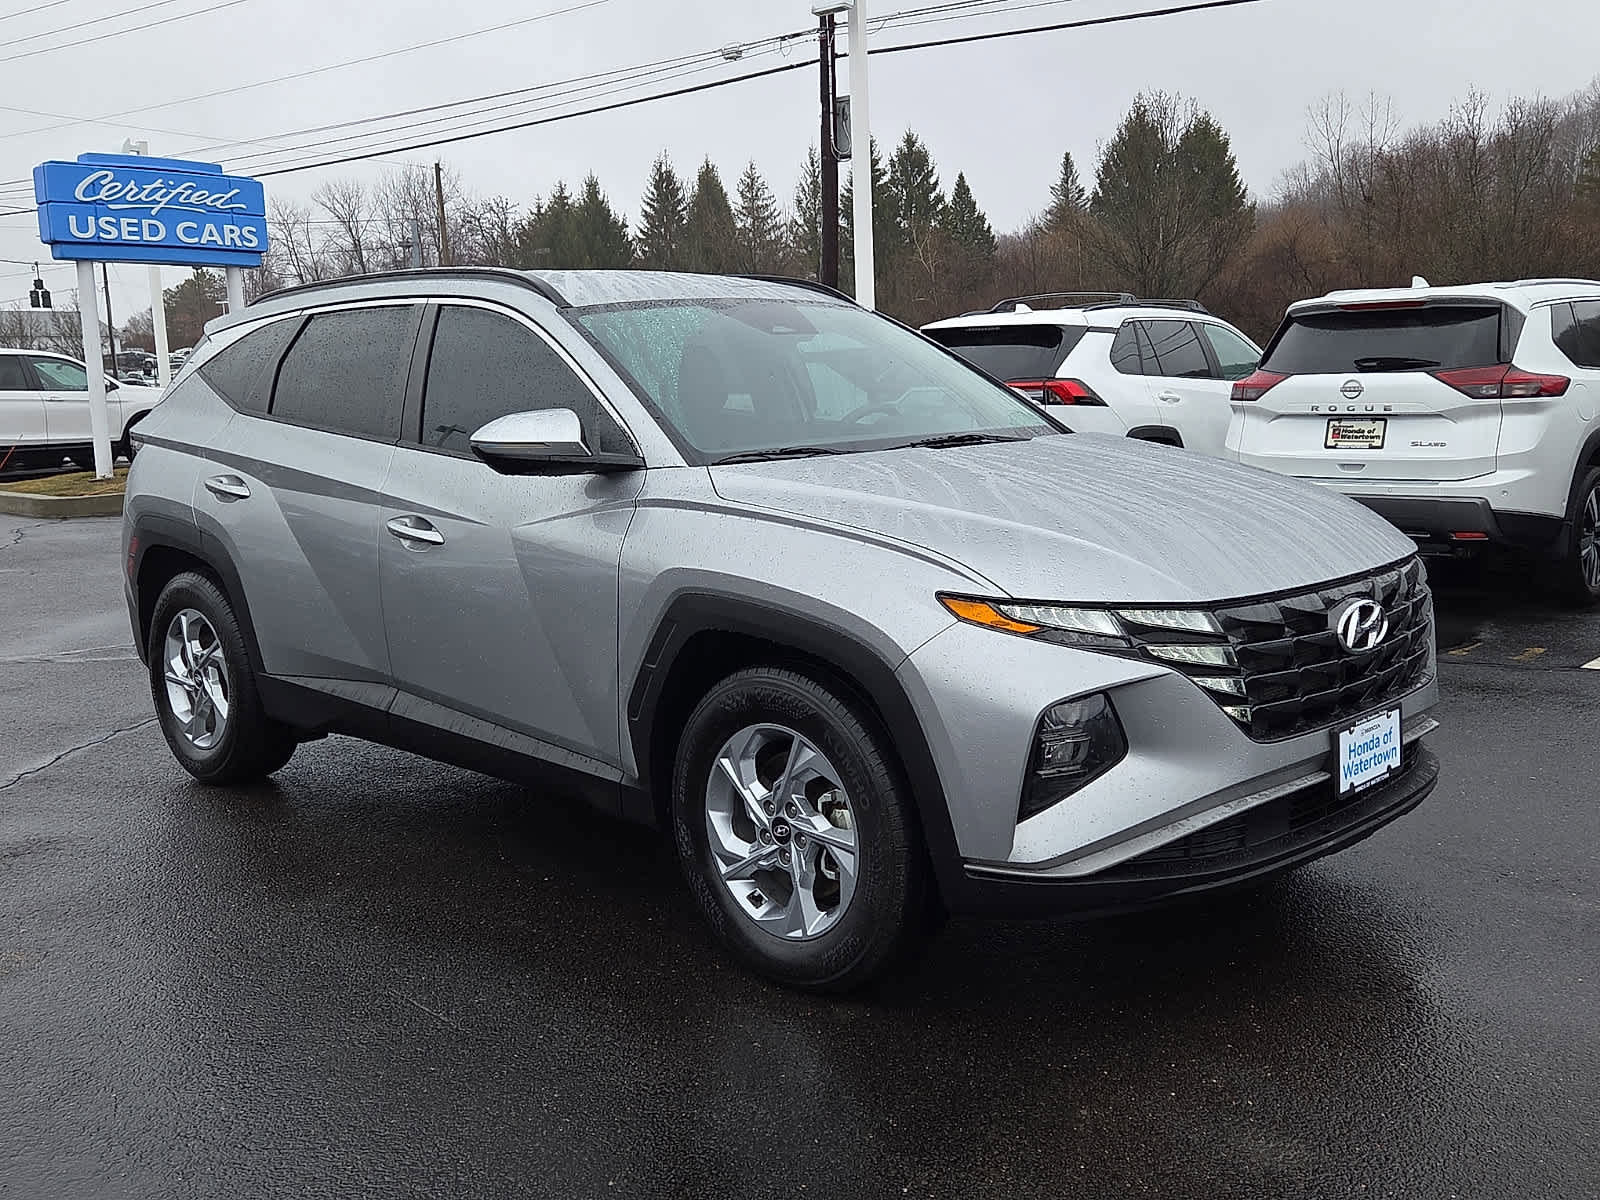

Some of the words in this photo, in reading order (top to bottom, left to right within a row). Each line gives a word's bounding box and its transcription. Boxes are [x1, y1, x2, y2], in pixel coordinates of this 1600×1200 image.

[75, 171, 247, 216] Certified
[68, 215, 167, 242] USED
[176, 222, 259, 248] CARS
[1348, 734, 1380, 760] Honda
[1382, 726, 1393, 745] of
[1342, 746, 1397, 780] Watertown
